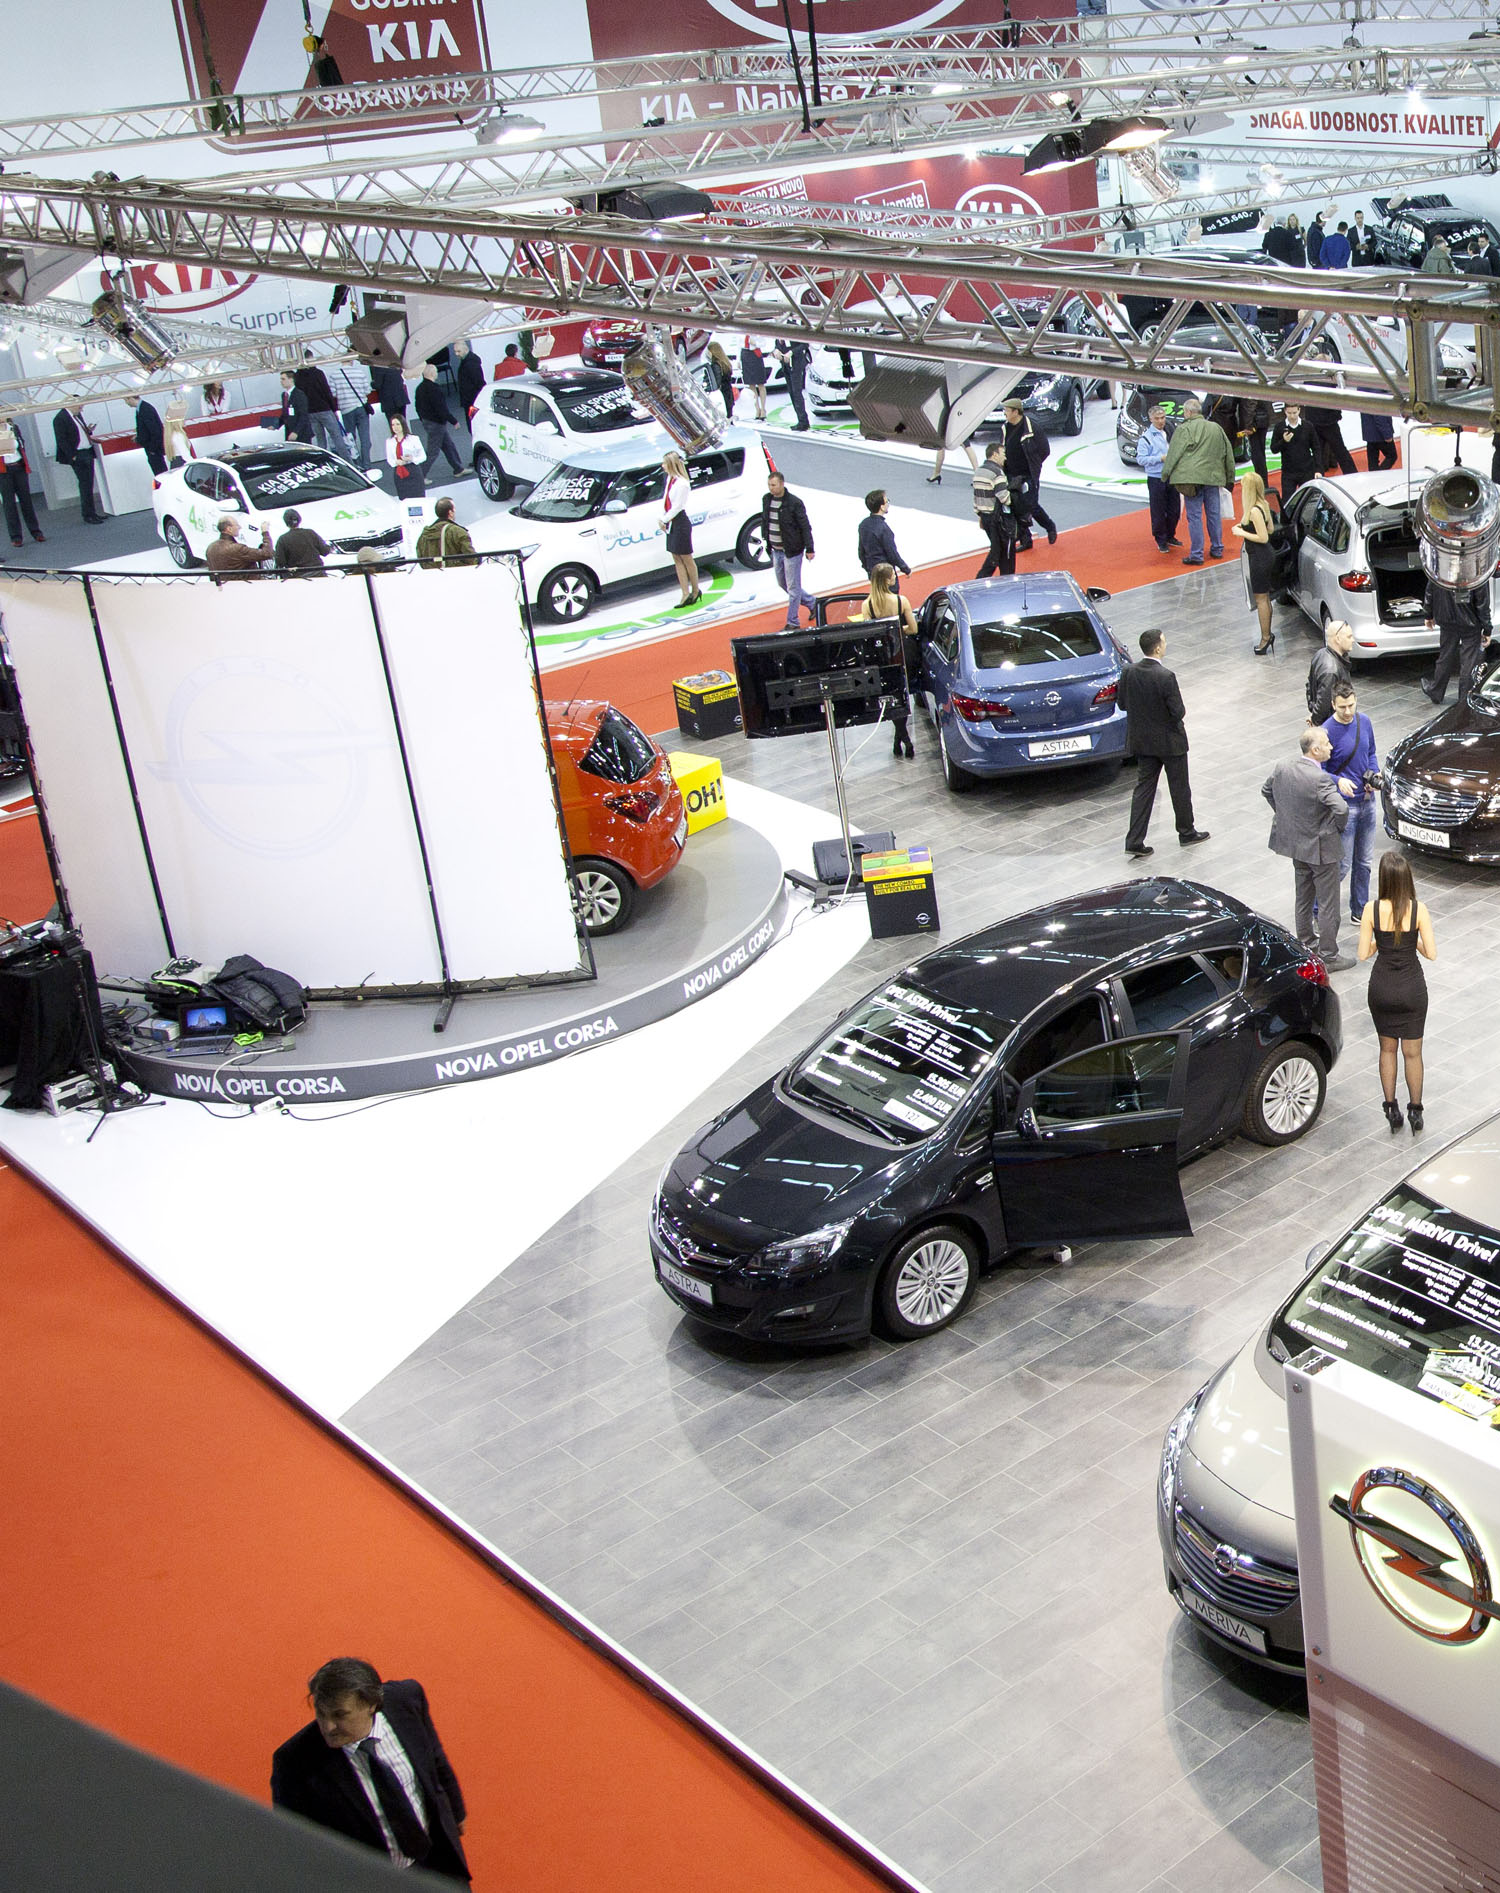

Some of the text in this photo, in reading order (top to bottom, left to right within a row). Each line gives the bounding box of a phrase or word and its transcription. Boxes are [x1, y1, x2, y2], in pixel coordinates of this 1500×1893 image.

[366, 18, 461, 63] KIA
[641, 93, 697, 123] KIA
[1310, 111, 1402, 133] UDOBNOST.
[229, 305, 318, 332] Surprise
[257, 479, 278, 493] KIA
[277, 461, 318, 486] OPTIMA
[1041, 739, 1080, 753] ASTRA
[686, 777, 724, 814] OH!
[1402, 824, 1445, 845] INSIGNIA
[684, 919, 775, 999] NOVA OPEL CORSA
[885, 984, 907, 1001] OPEL
[903, 992, 934, 1014] ASTRA
[931, 1004, 962, 1025] Drive!
[436, 1015, 620, 1080] NOVA OPEL CORSA
[174, 1072, 346, 1096] NOVA OPEL CORSA
[947, 1082, 967, 1097] EUR
[933, 1098, 953, 1113] EUR
[1373, 1206, 1500, 1264] OPEL MERIVA Drive!
[668, 1267, 702, 1297] ASTRA
[1194, 1596, 1252, 1643] MERIVA
